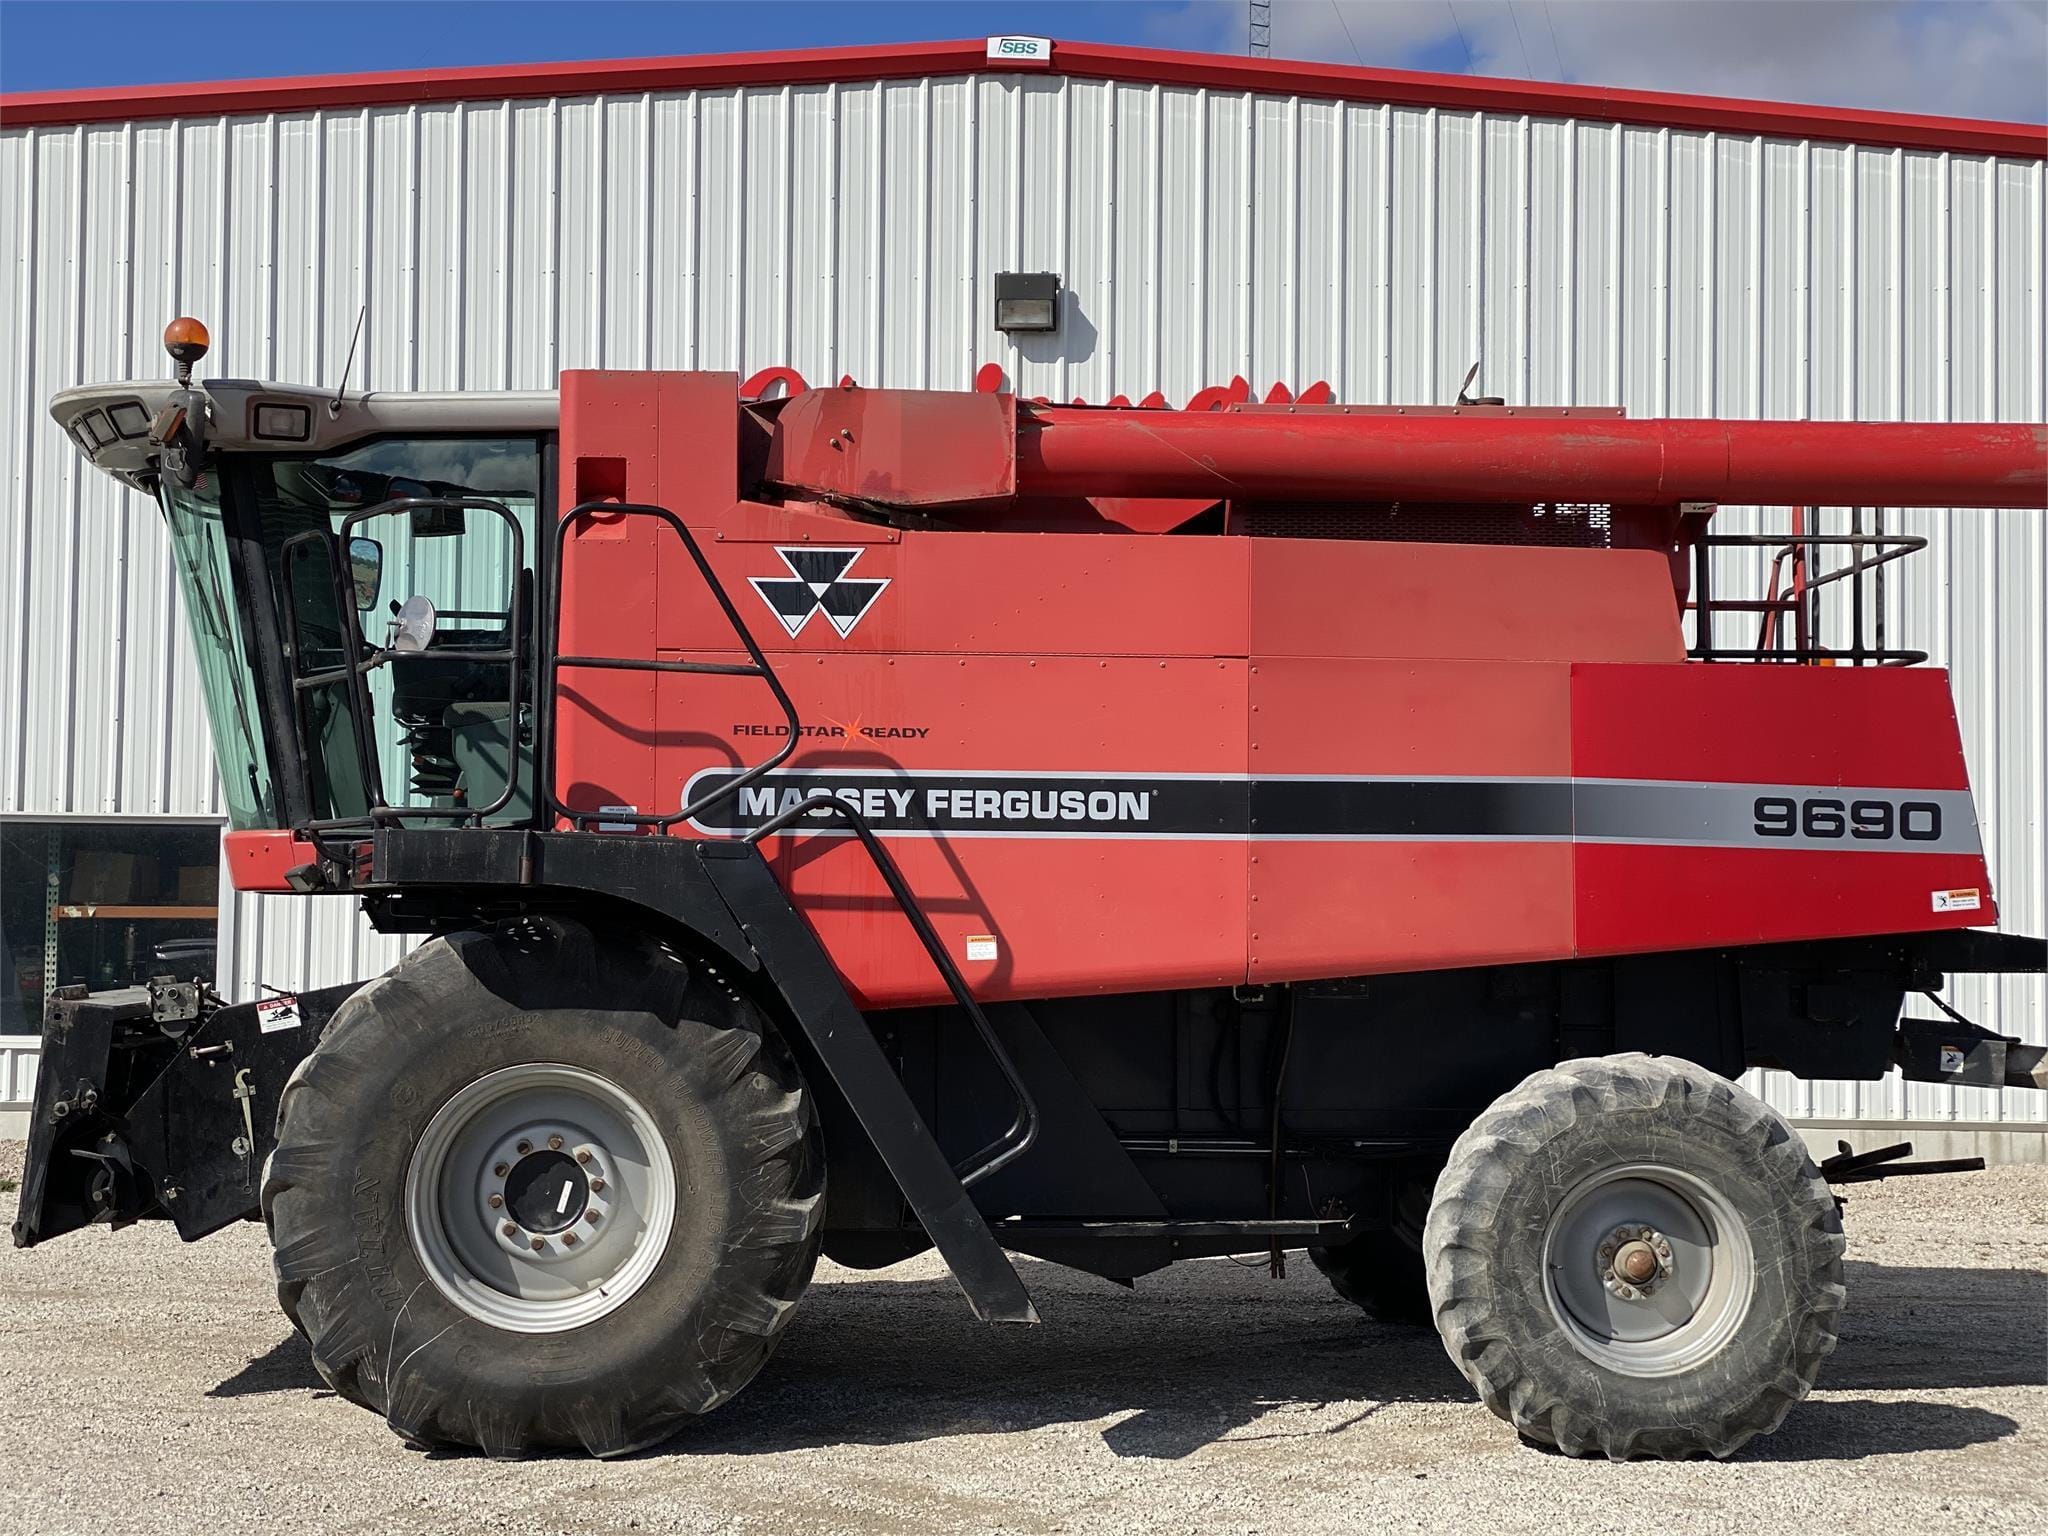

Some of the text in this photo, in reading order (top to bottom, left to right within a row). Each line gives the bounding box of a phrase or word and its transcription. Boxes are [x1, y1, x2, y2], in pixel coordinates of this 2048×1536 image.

[1001, 42, 1038, 54] SBS
[860, 727, 930, 739] READY
[927, 789, 1149, 820] FERGUSON
[1754, 797, 1942, 841] 9690
[353, 1167, 402, 1312] TITAN
